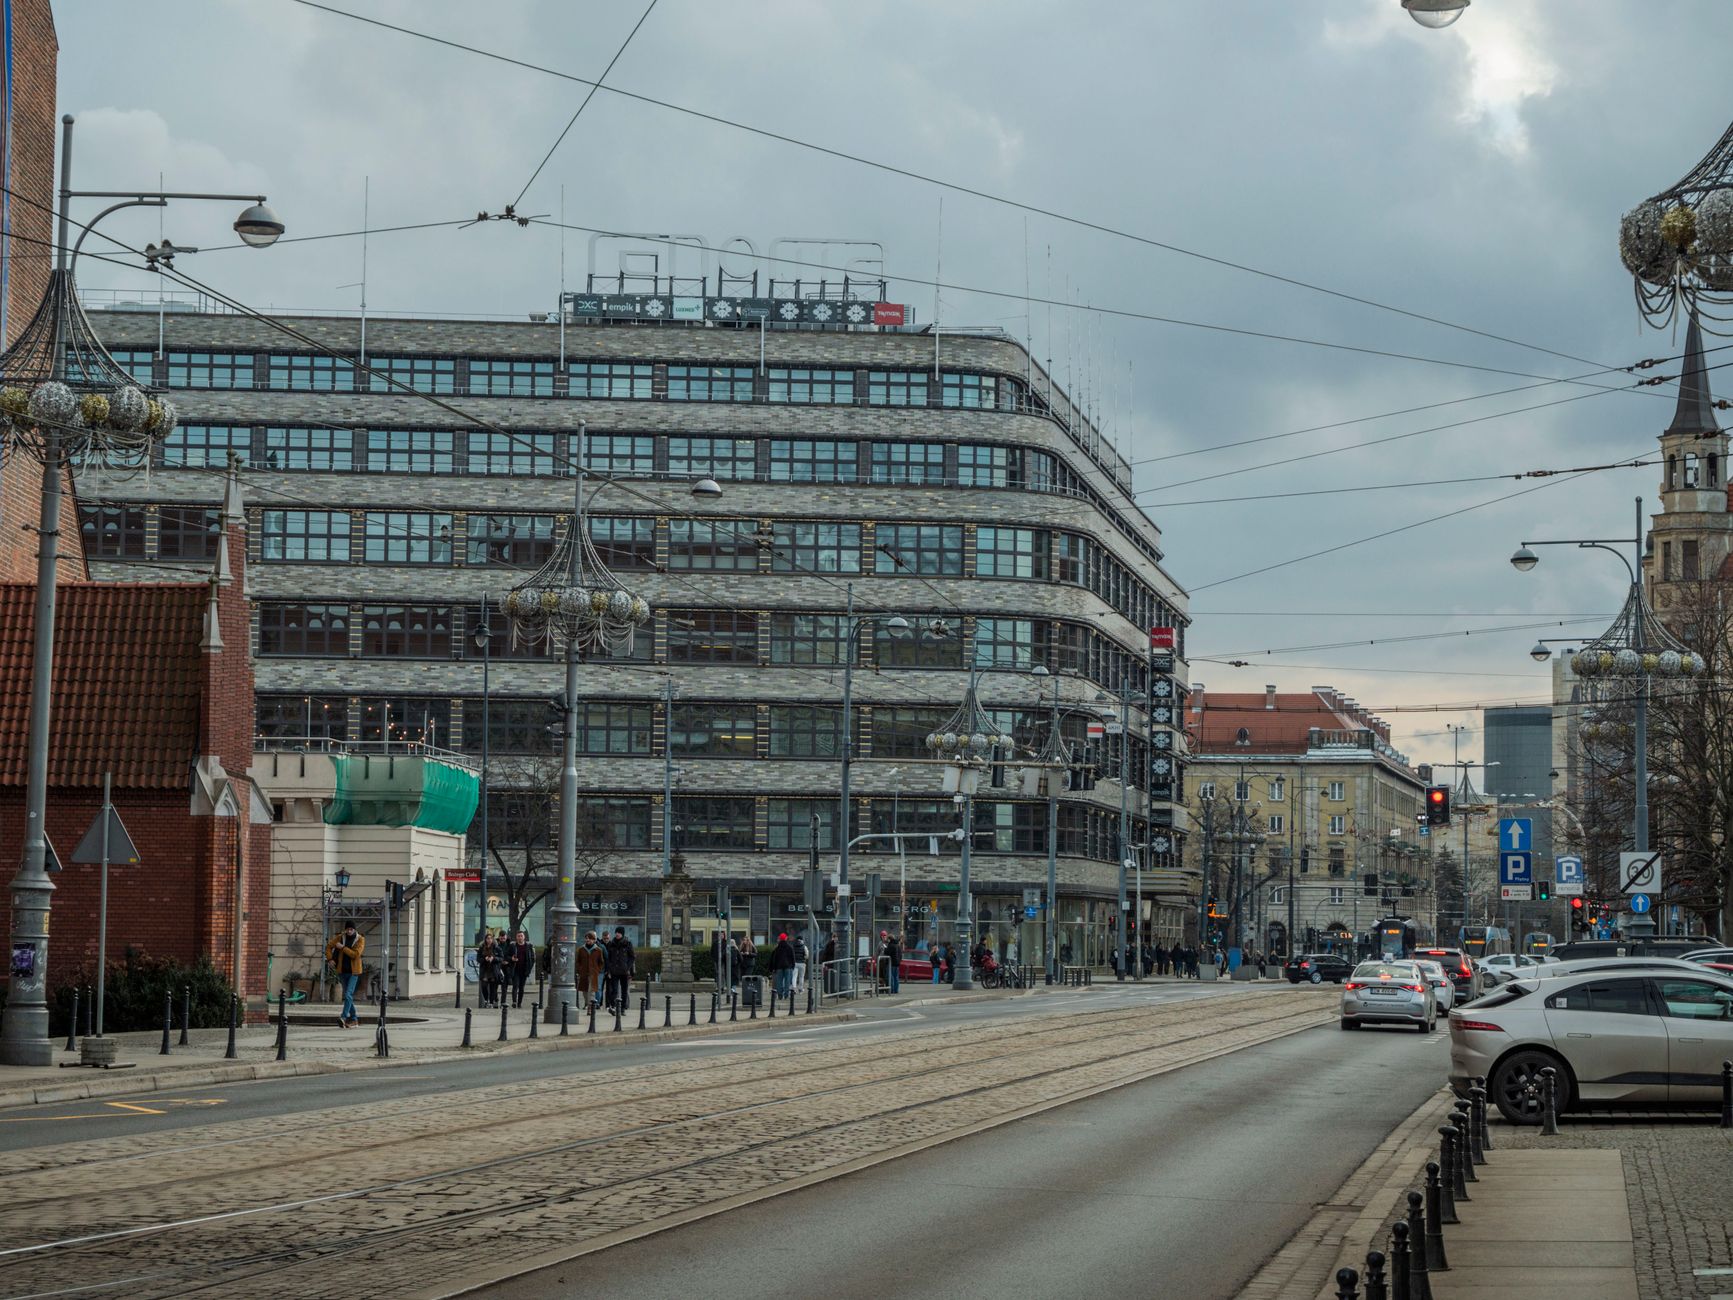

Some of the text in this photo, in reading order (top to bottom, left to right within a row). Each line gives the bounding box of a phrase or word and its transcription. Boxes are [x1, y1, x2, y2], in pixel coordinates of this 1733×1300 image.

[608, 303, 634, 313] empik
[1507, 856, 1524, 880] P
[1562, 862, 1576, 880] P
[1631, 866, 1650, 879] 30
[582, 901, 628, 910] BERG'S
